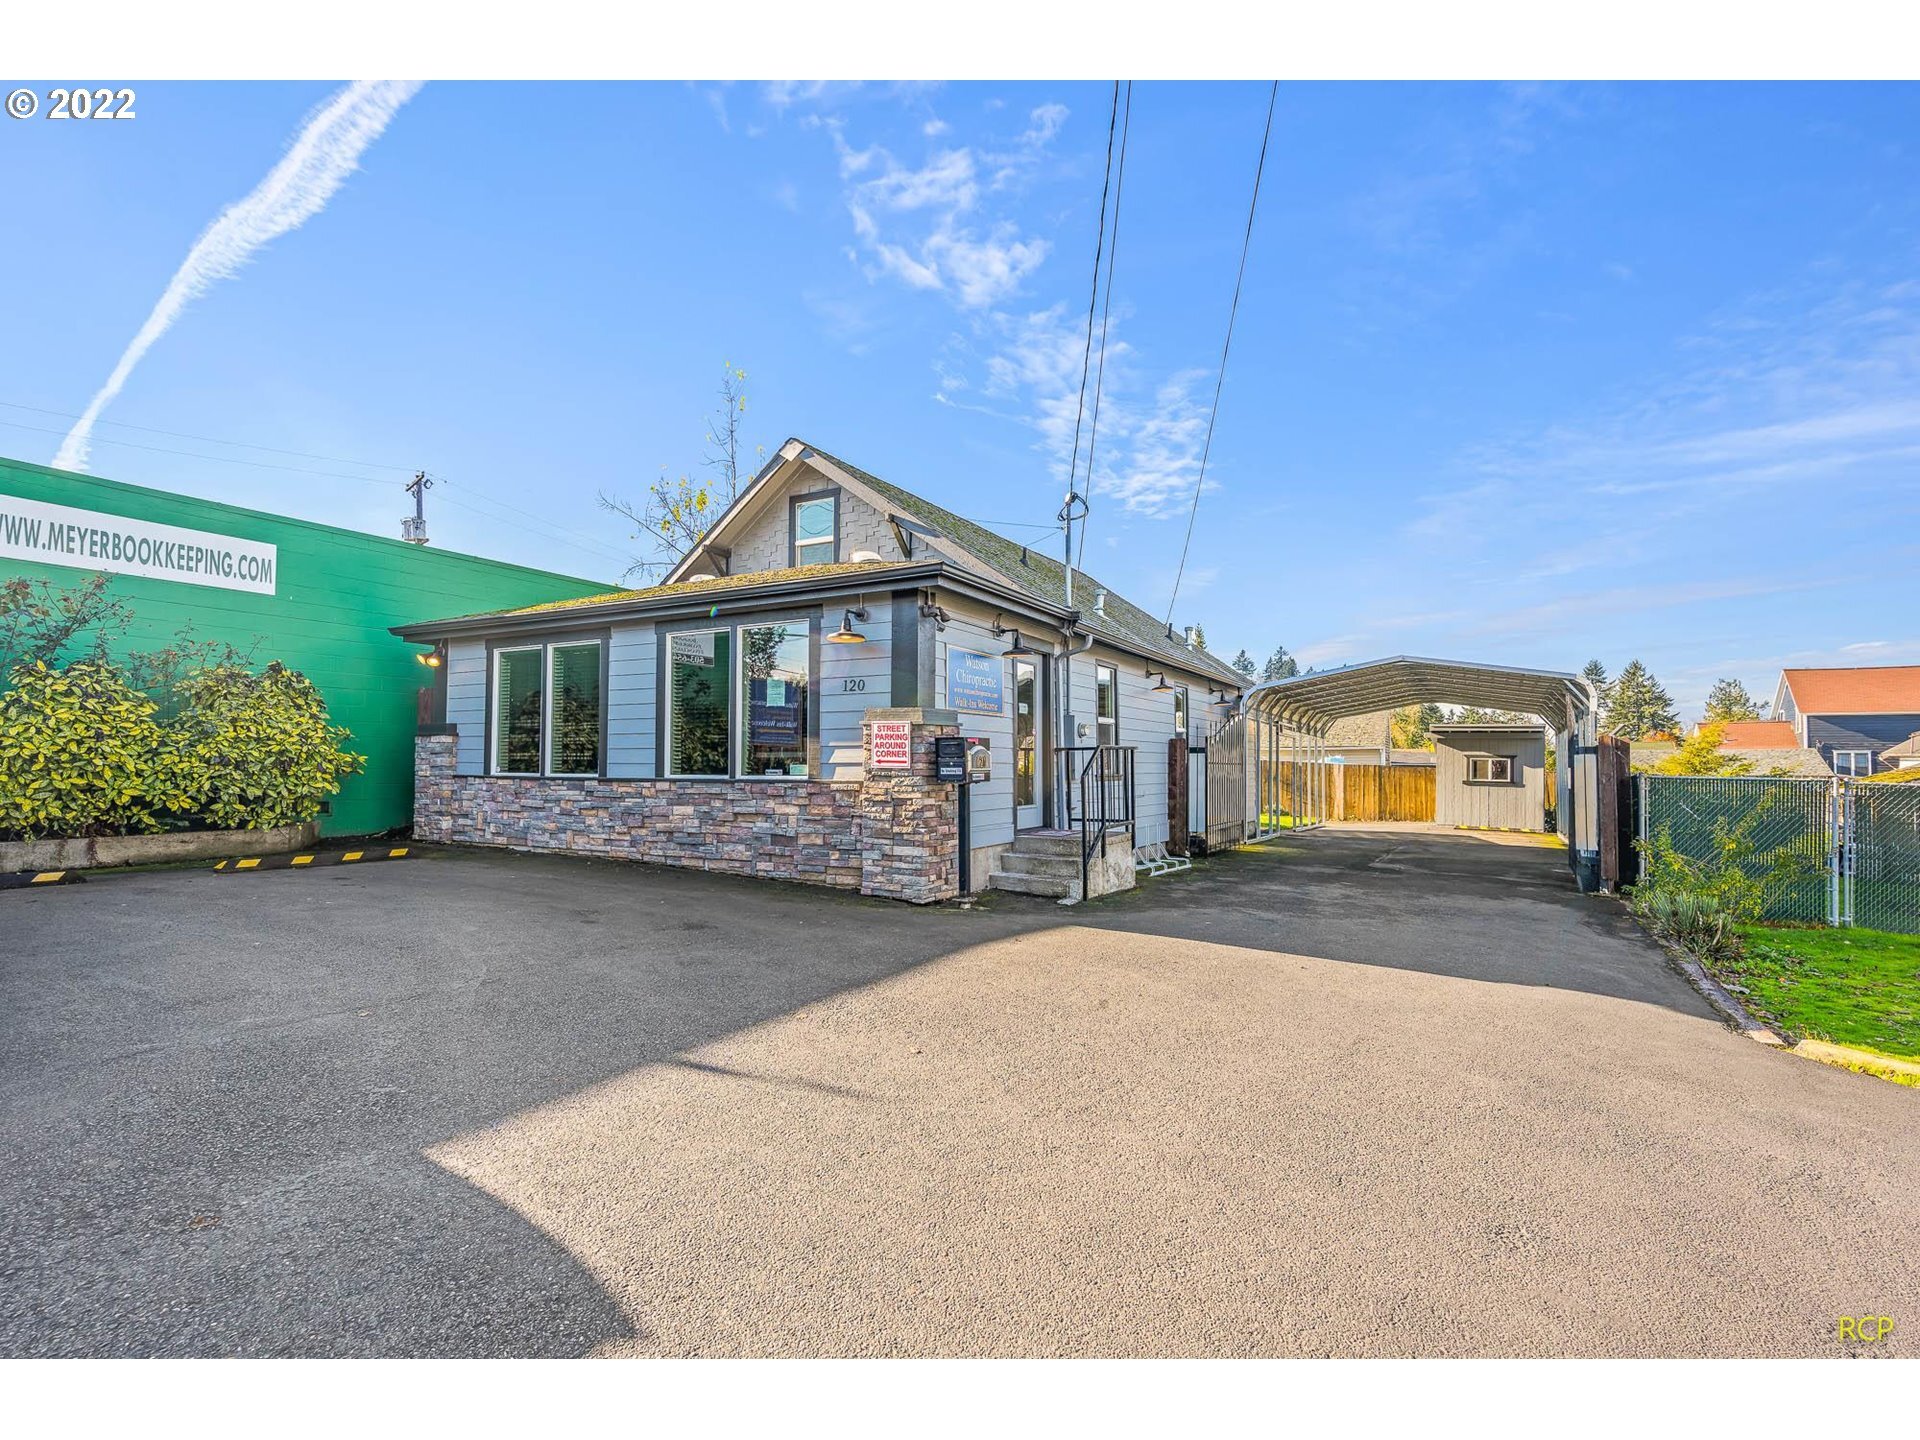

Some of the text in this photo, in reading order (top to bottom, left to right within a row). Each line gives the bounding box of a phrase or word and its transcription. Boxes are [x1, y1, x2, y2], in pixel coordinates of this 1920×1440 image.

[0, 513, 273, 585] WW.MEYERBOOKKEEPING.COM
[964, 653, 990, 672] Watson
[842, 679, 866, 692] 120
[876, 724, 906, 733] STREET
[874, 733, 908, 741] PARKING
[874, 741, 907, 749] AROUND
[875, 749, 908, 758] CORNER
